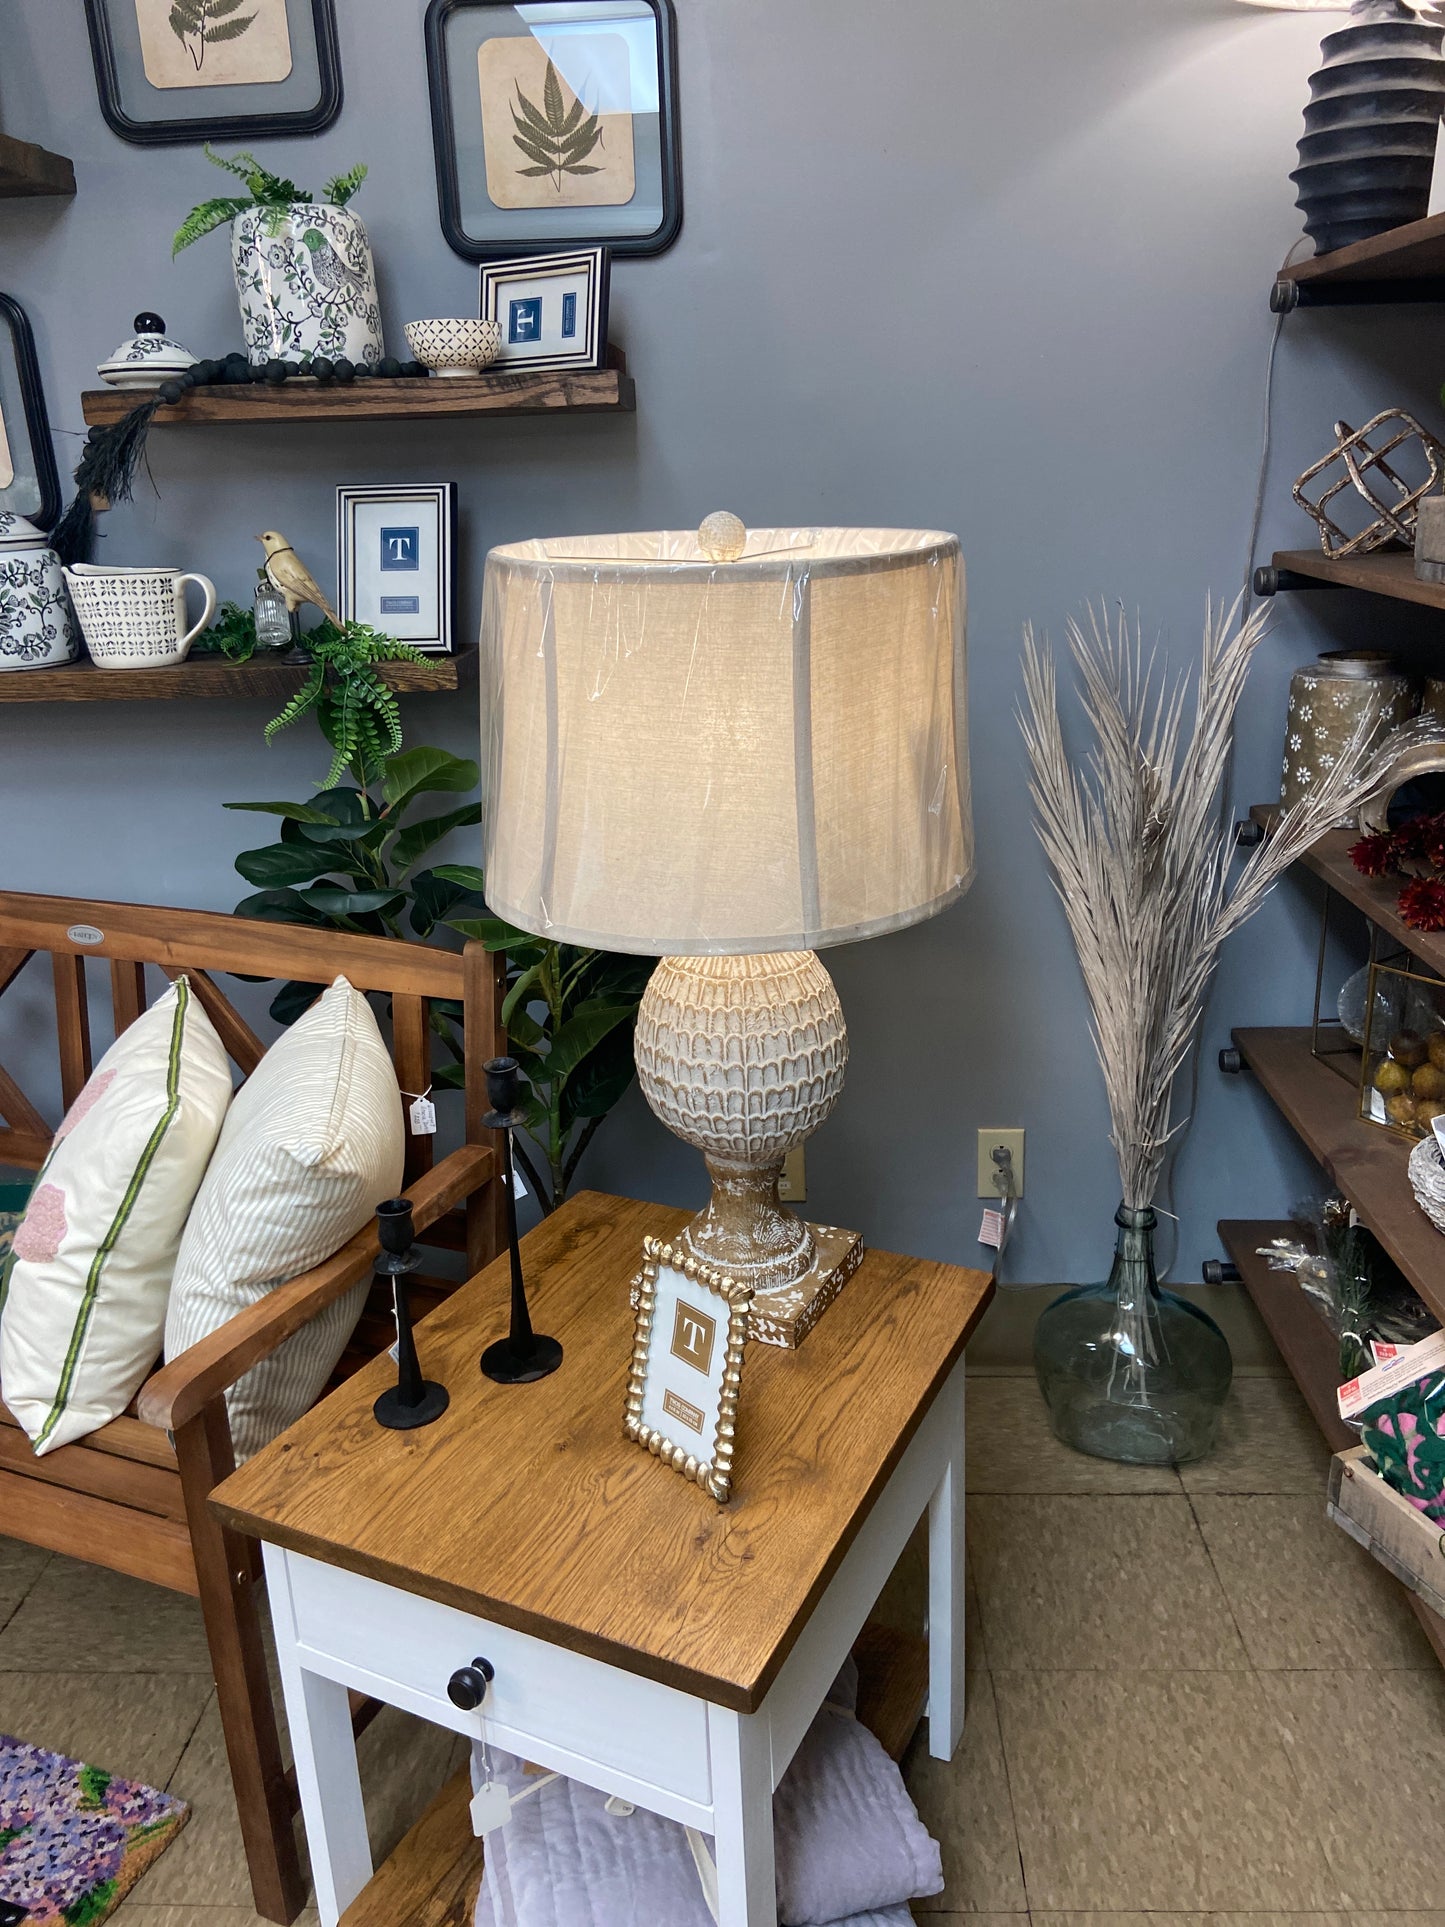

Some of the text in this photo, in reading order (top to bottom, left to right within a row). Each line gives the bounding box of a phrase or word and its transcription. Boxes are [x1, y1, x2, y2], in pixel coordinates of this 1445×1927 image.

[516, 308, 535, 333] T
[389, 537, 411, 561] T
[683, 1317, 706, 1355] T
